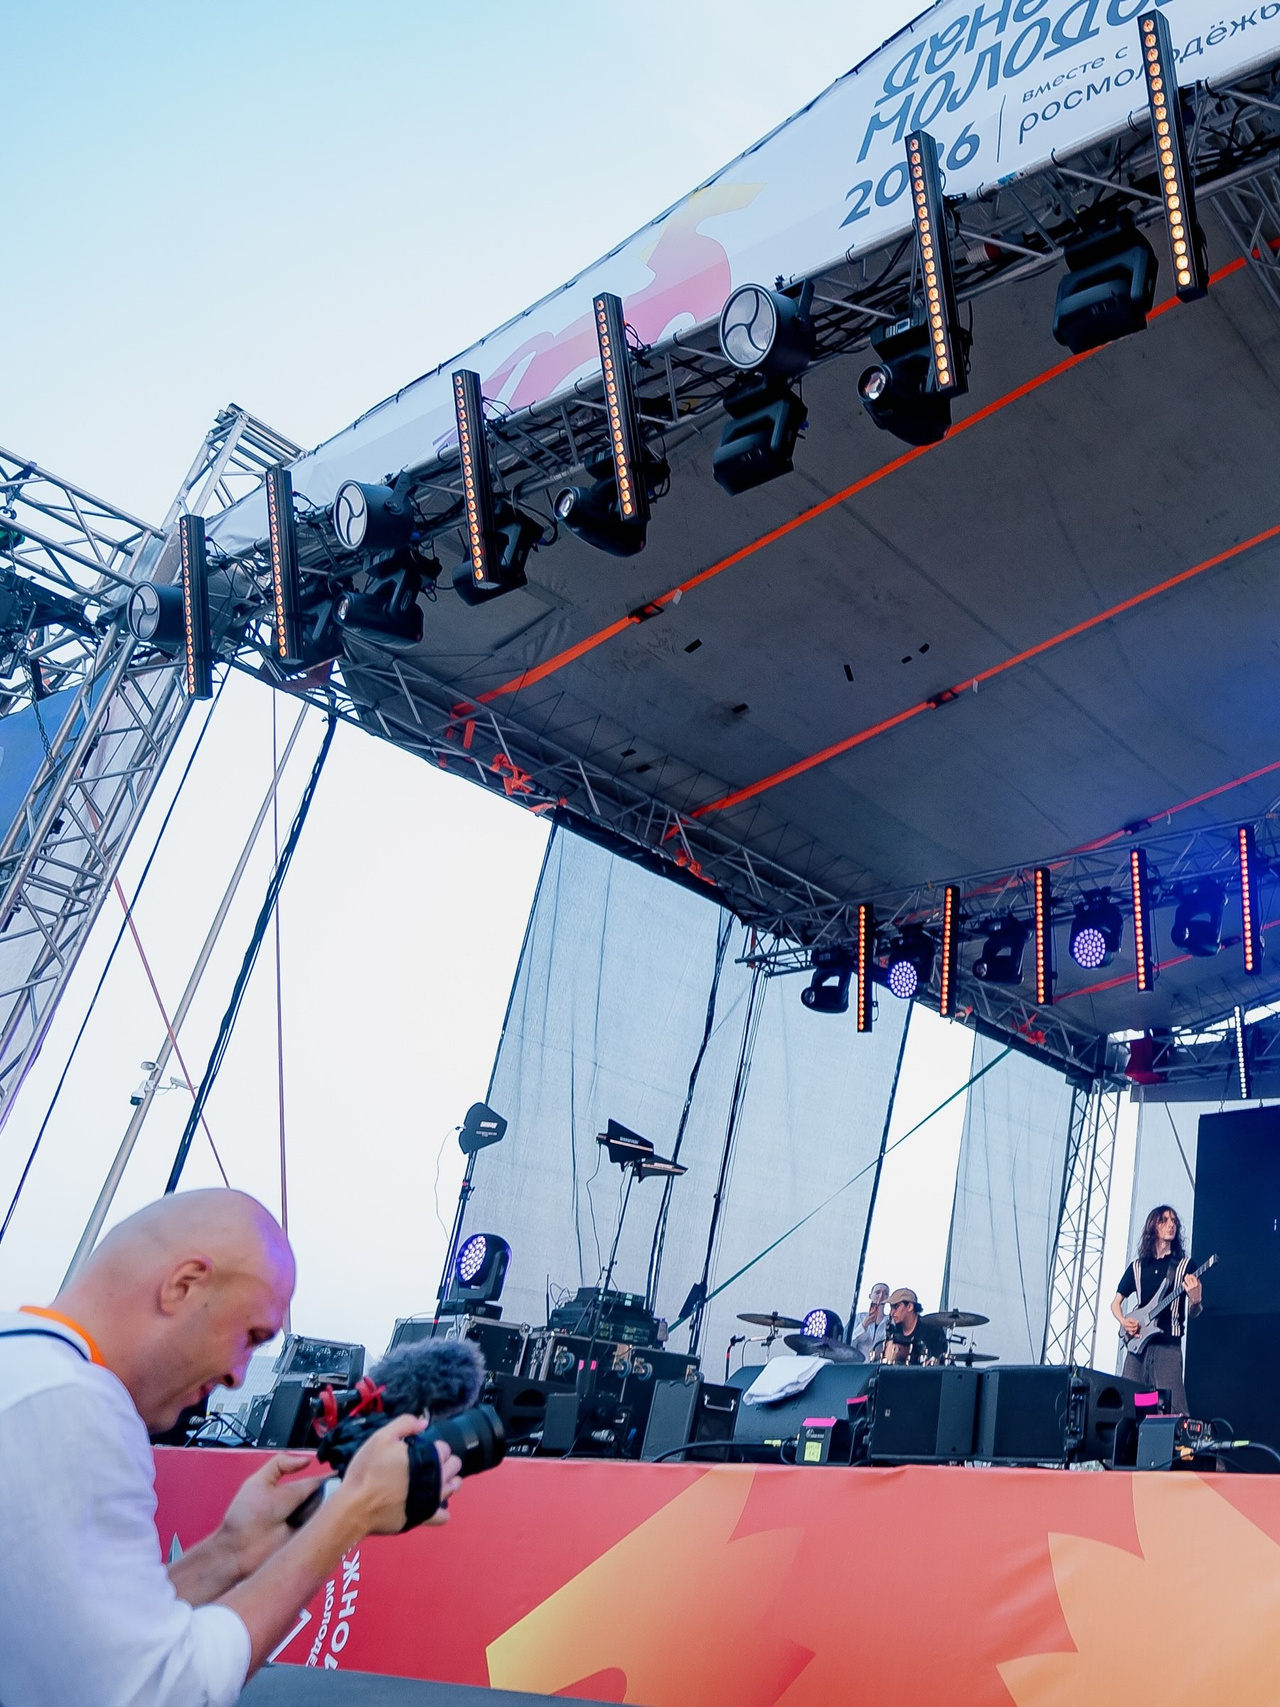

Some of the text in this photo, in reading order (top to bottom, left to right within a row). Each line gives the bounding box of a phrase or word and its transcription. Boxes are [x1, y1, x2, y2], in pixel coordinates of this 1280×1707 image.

[1022, 46, 1129, 103] вместе с
[838, 121, 980, 229] 206
